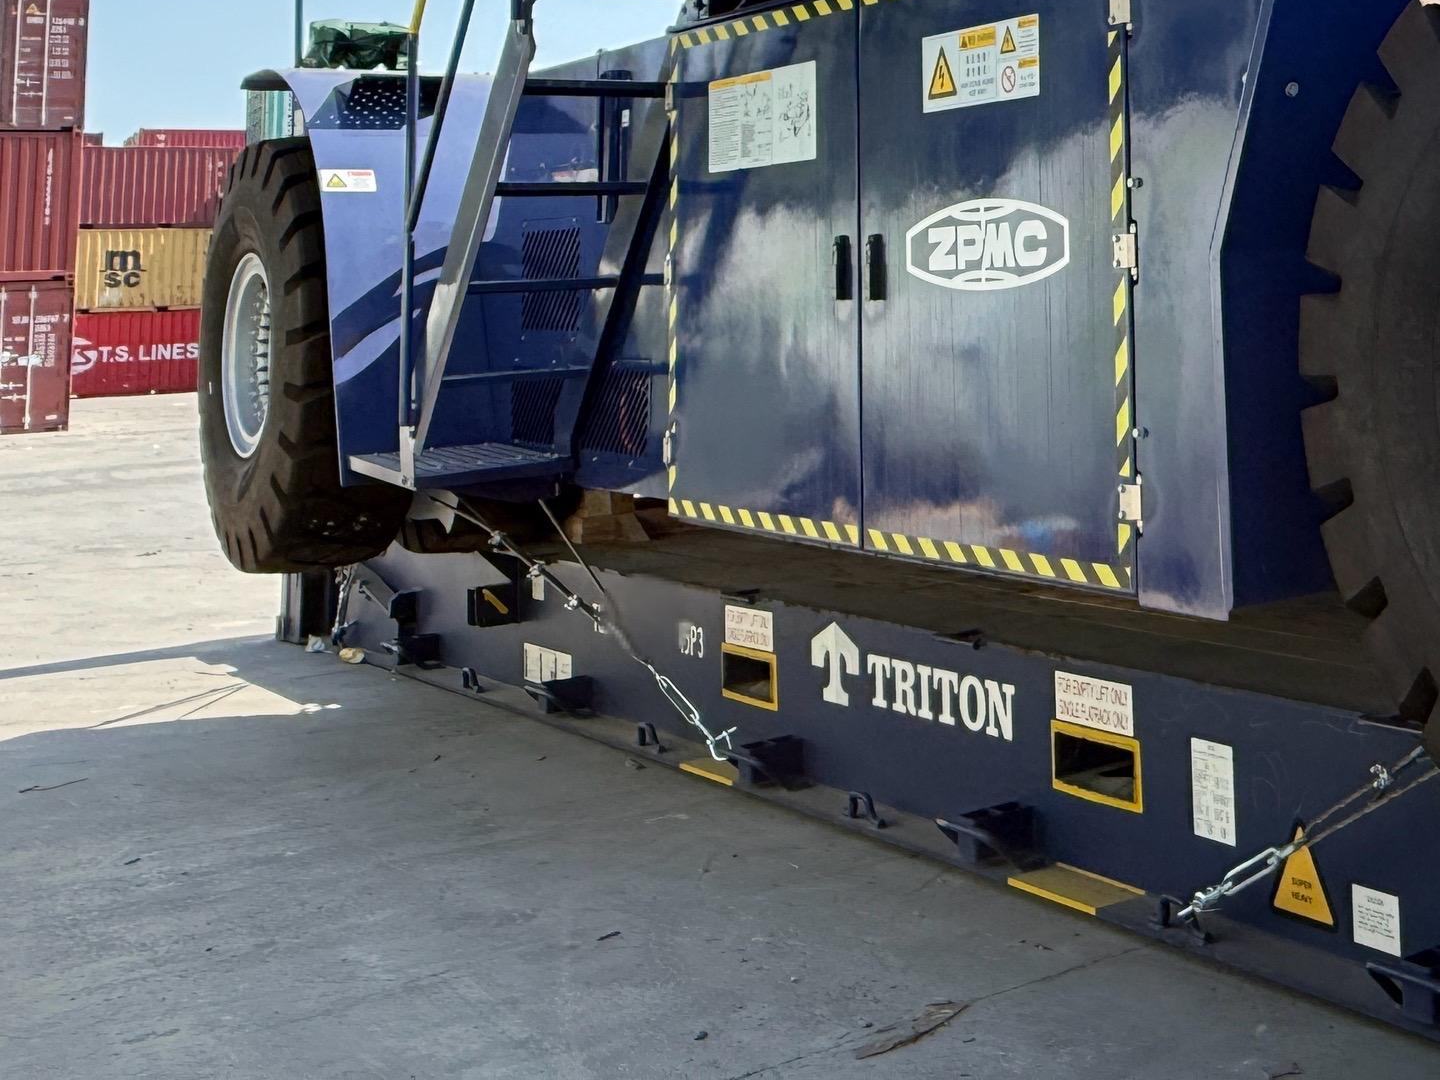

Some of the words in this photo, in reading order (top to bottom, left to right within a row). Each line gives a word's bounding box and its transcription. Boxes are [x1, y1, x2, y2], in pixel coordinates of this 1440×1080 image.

[928, 219, 1048, 271] ZPMC
[98, 345, 134, 363] T.S.
[139, 342, 200, 361] LINES
[867, 653, 1016, 742] TRITON
